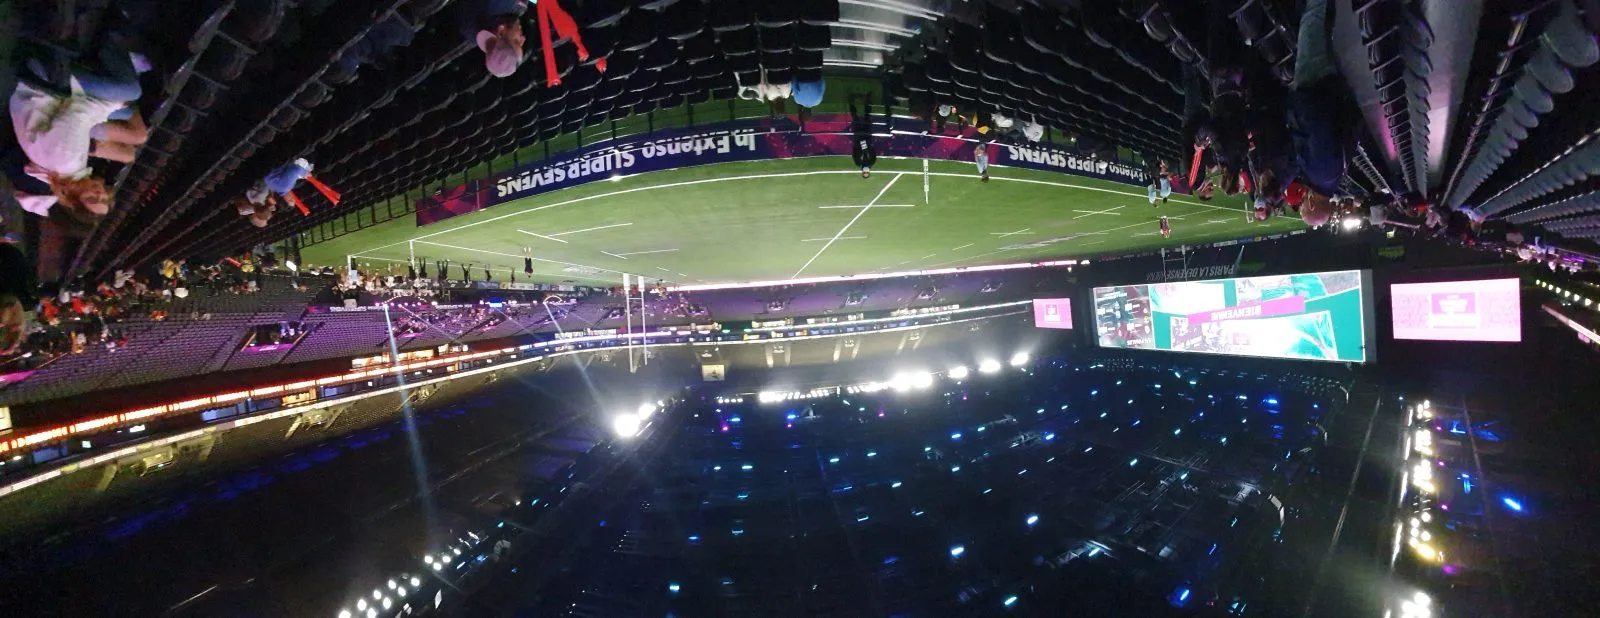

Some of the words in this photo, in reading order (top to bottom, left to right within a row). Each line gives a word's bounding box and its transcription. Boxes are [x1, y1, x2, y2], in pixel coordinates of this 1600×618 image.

[641, 130, 731, 159] Extenso
[731, 129, 756, 151] In
[1199, 267, 1209, 278] LA
[1209, 264, 1235, 277] PARIS
[1210, 304, 1262, 321] BIENVENUE
